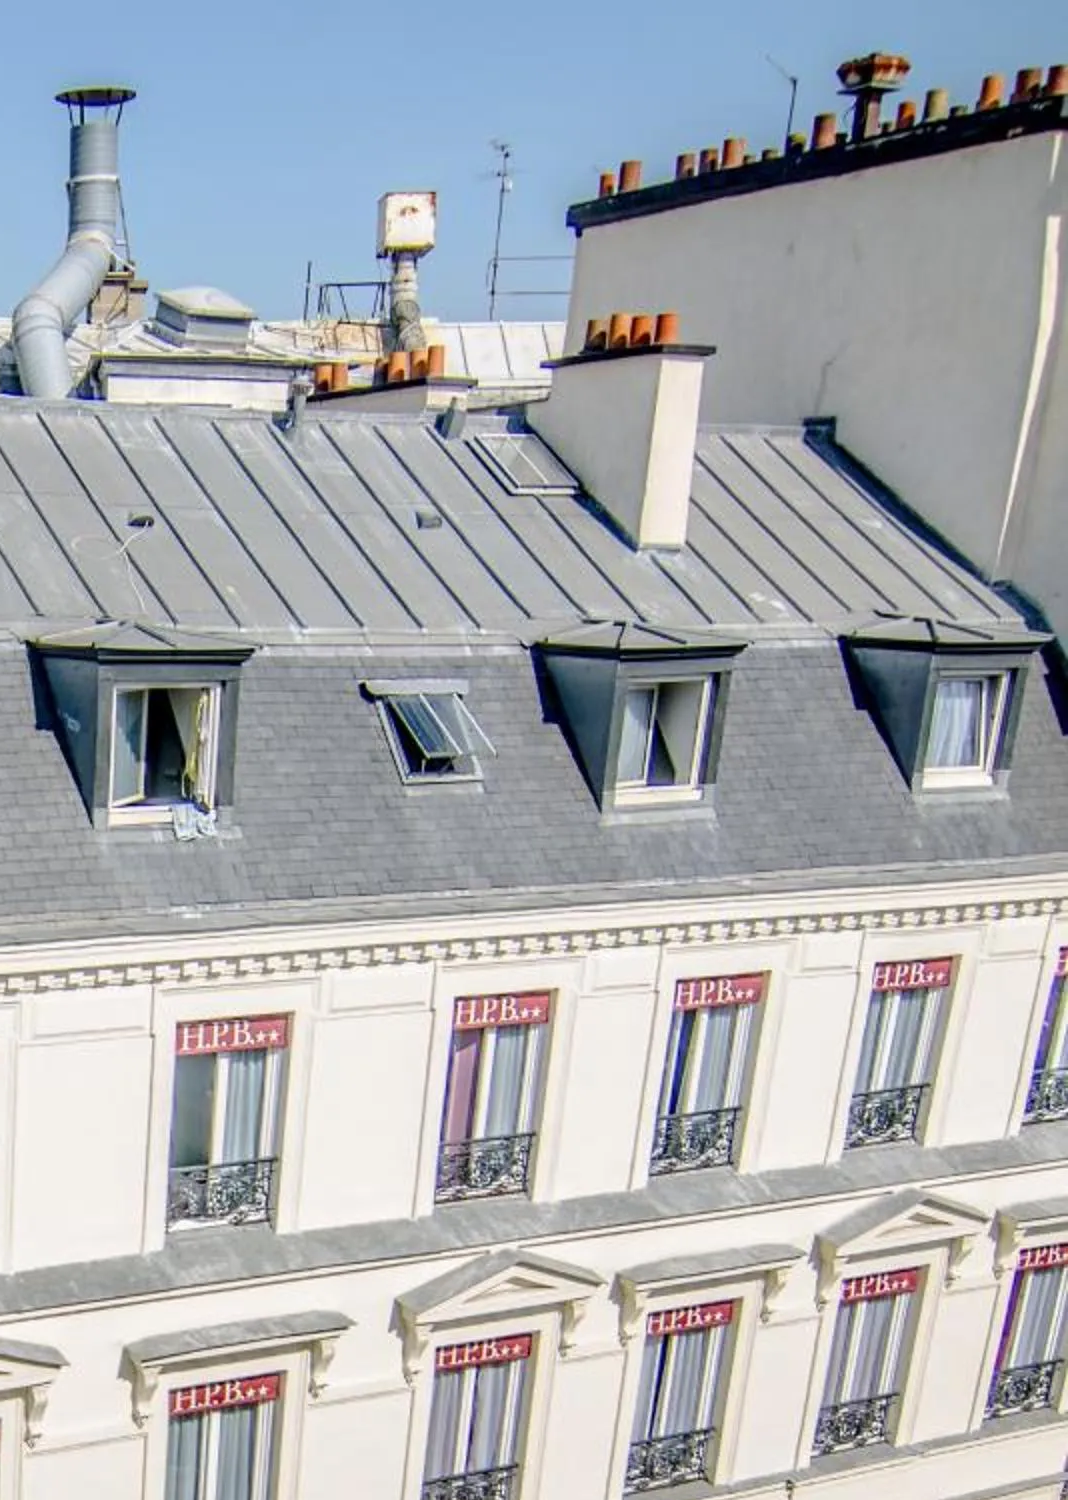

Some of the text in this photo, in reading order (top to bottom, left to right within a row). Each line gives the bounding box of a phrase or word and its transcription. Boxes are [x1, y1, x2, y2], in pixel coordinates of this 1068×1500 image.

[873, 963, 926, 989] H.P.B.
[675, 980, 734, 1008] H.P.B.
[454, 997, 519, 1025] H.P.B.
[182, 1021, 254, 1051] H.P.B.
[175, 1382, 243, 1411] H.P.B.
